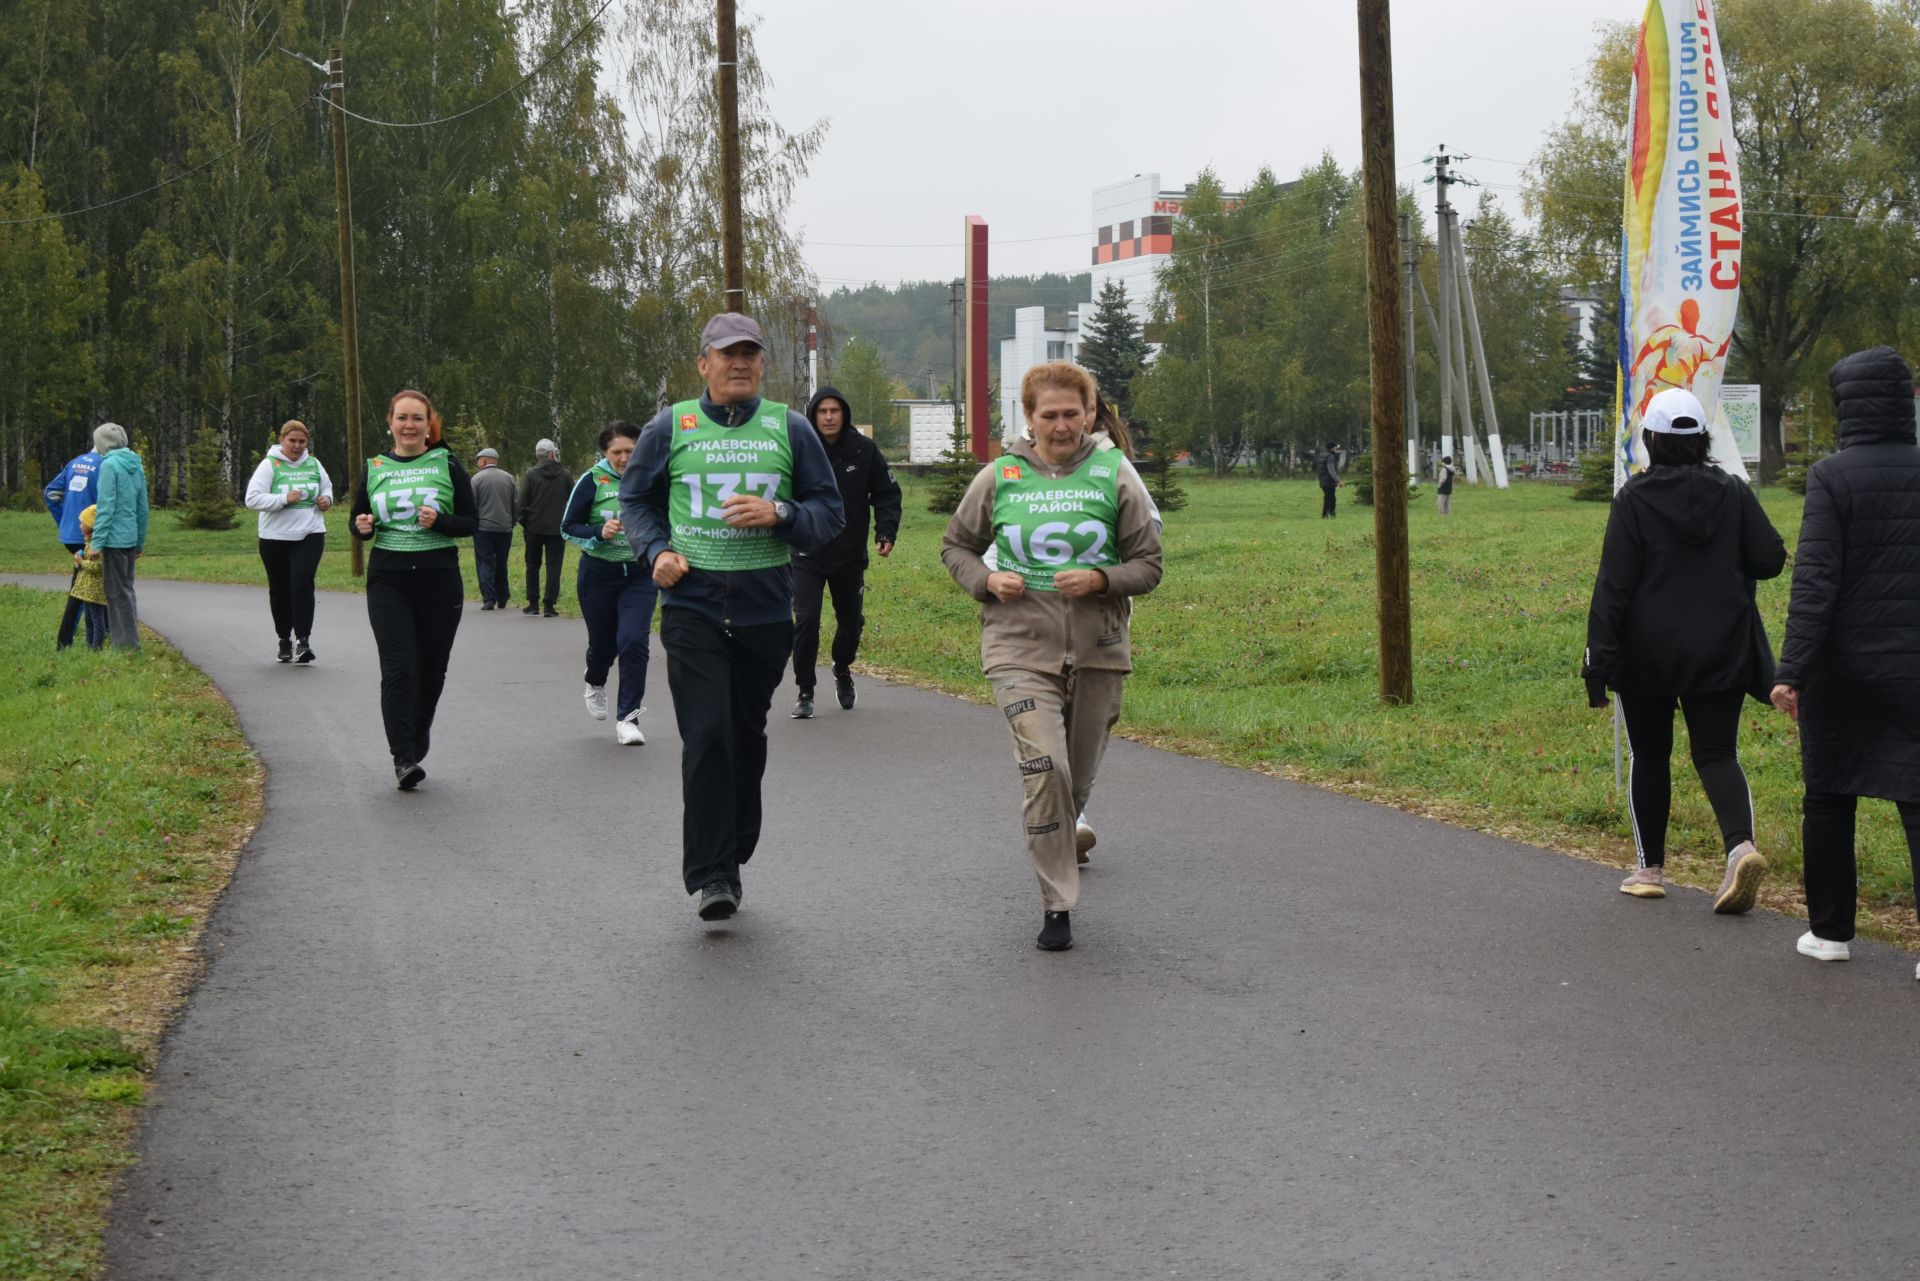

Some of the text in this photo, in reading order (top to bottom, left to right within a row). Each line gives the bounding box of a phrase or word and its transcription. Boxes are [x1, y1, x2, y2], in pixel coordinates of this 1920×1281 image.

[1675, 22, 1703, 291] ЗАЙМИСЬ СПОРТОМ
[687, 439, 778, 452] ТУКАЕВСКИЙ
[705, 450, 758, 464] РАЙОН
[390, 475, 424, 486] РАЙОН
[681, 473, 781, 520] 137
[1008, 489, 1105, 503] ТУКАЕВСКИЙ
[373, 487, 439, 523] 133
[1028, 500, 1084, 514] РАЙОН
[1003, 520, 1108, 566] 162
[1005, 700, 1034, 717] SIMPLE
